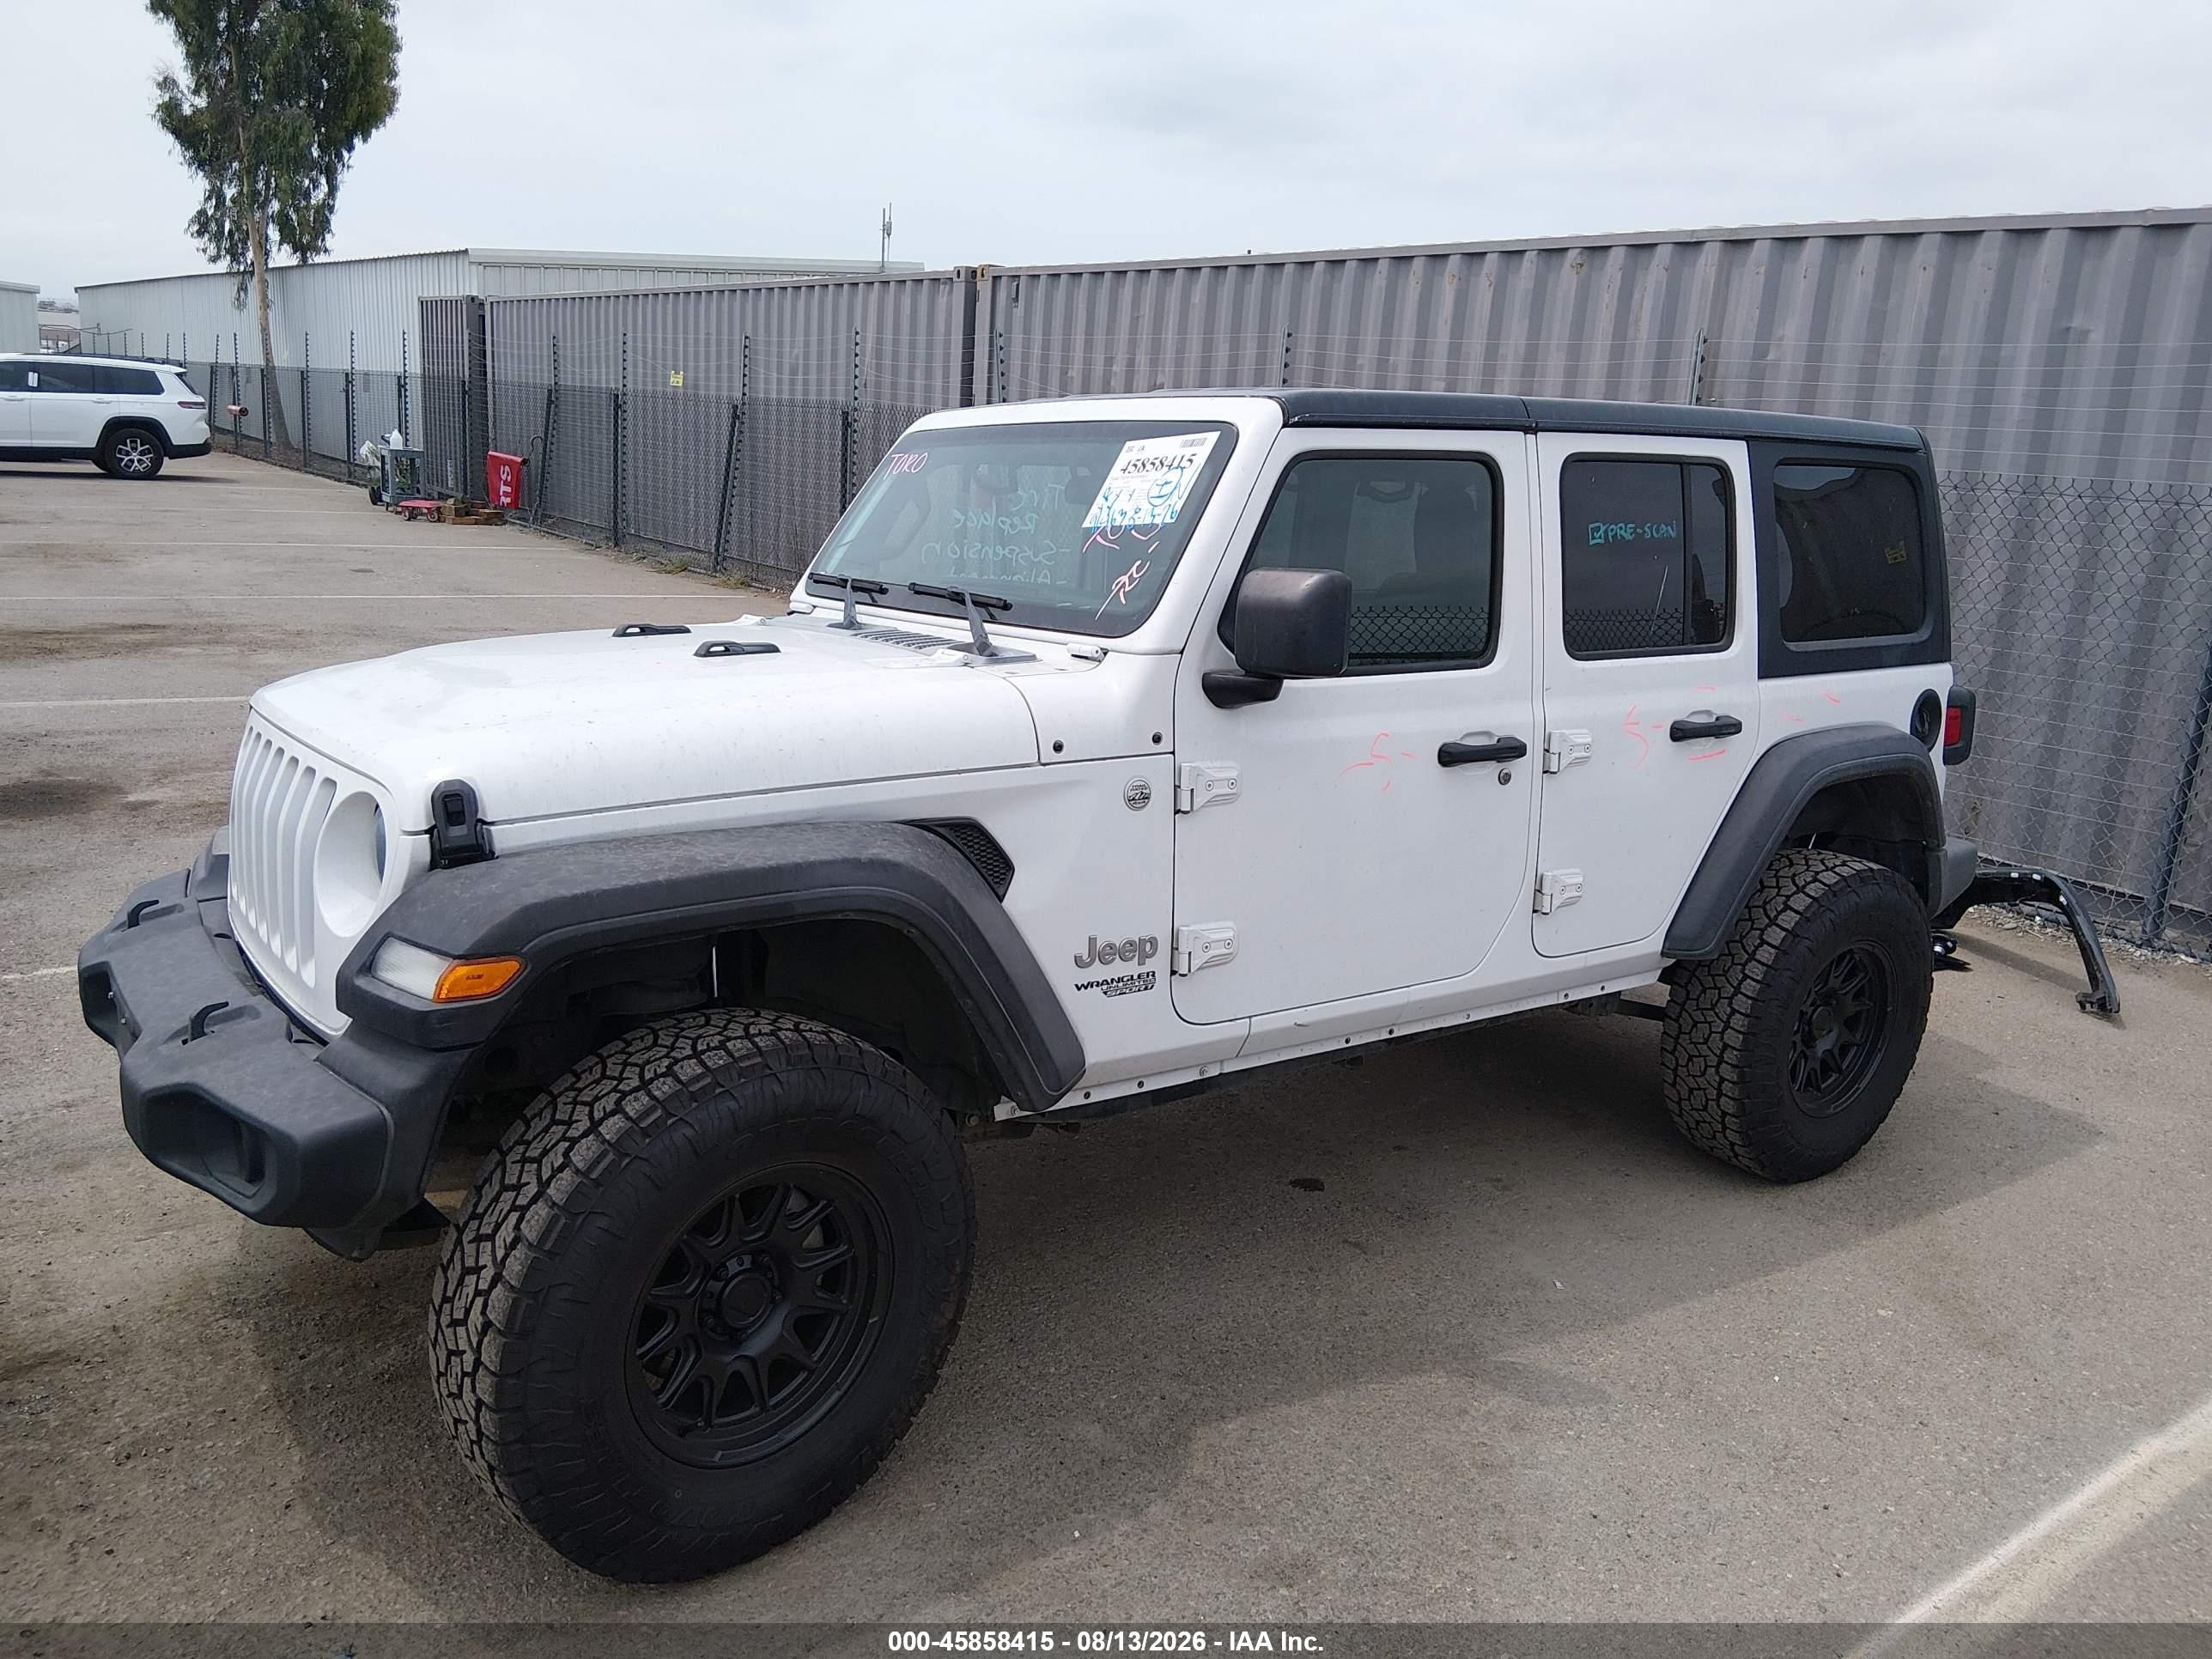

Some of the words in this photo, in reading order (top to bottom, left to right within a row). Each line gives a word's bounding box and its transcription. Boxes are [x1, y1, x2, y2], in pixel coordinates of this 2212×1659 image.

[1120, 453, 1198, 474] 45858415
[1074, 934, 1158, 969] Jeep
[1074, 970, 1157, 992] WRANGLER
[1103, 984, 1153, 997] SPORT
